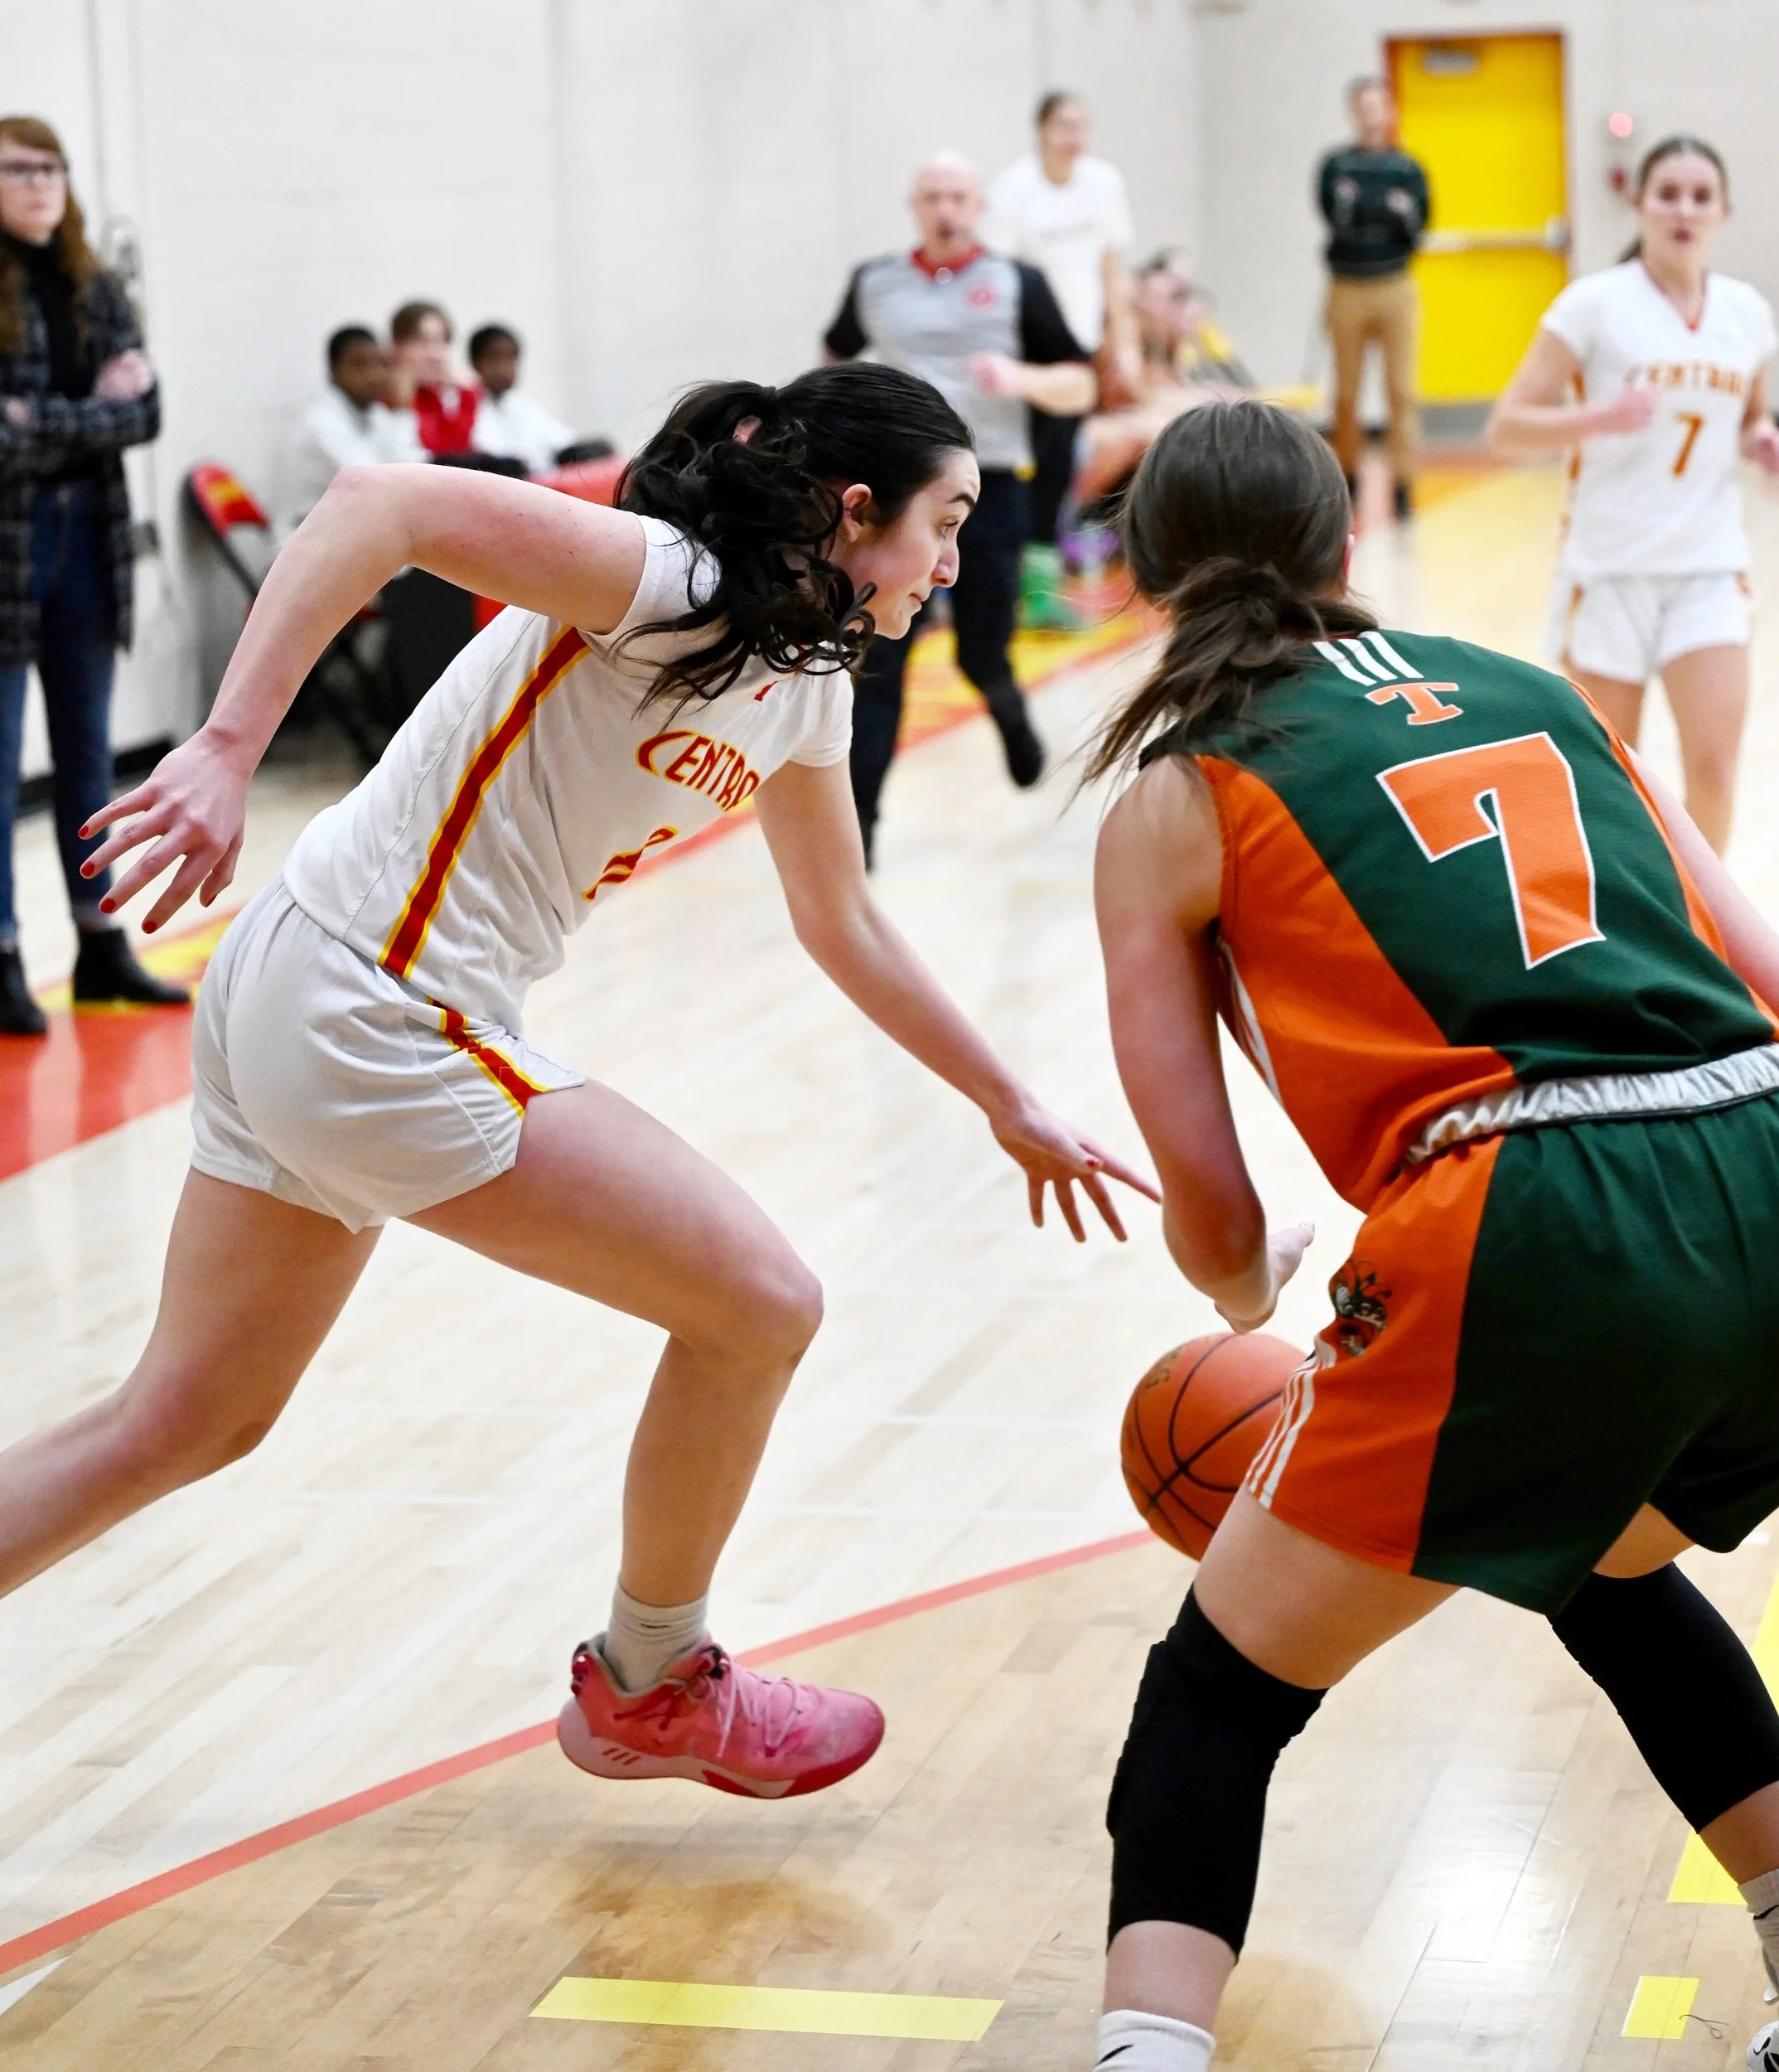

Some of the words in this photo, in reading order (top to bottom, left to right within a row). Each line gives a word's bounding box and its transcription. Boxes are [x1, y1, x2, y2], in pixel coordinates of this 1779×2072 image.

[1671, 410, 1704, 477] 7
[1365, 682, 1463, 725] T
[1375, 731, 1606, 971] 7
